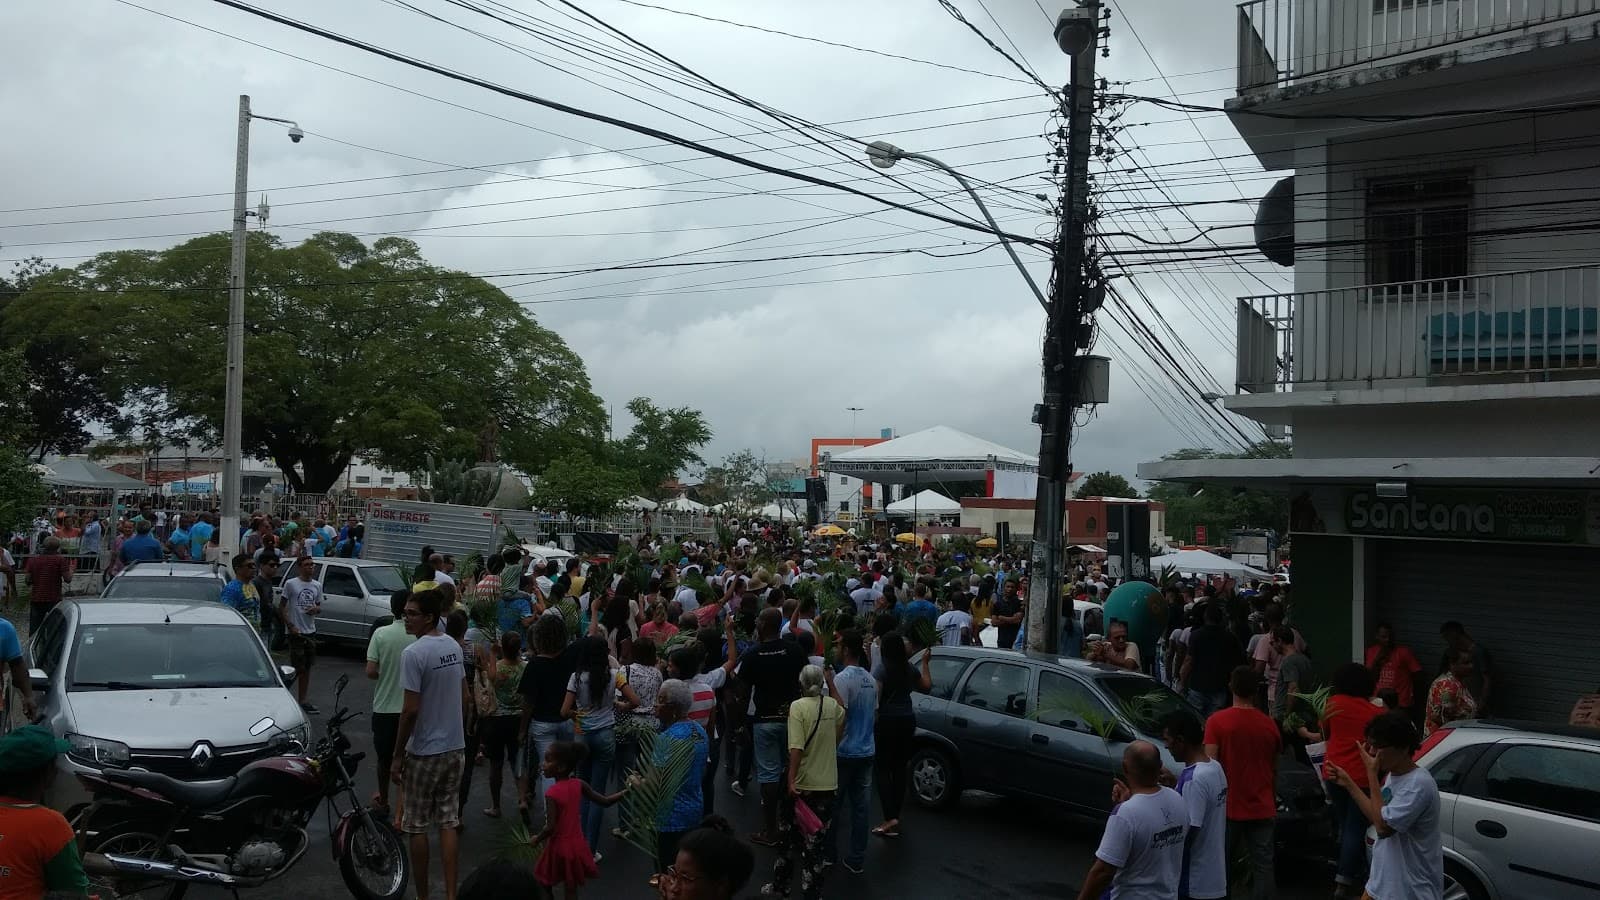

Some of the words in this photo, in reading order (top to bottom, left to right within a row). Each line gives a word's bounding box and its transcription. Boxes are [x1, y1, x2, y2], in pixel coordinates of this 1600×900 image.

[373, 508, 396, 520] DISK
[399, 511, 431, 523] FRETE
[1350, 491, 1495, 534] Santana
